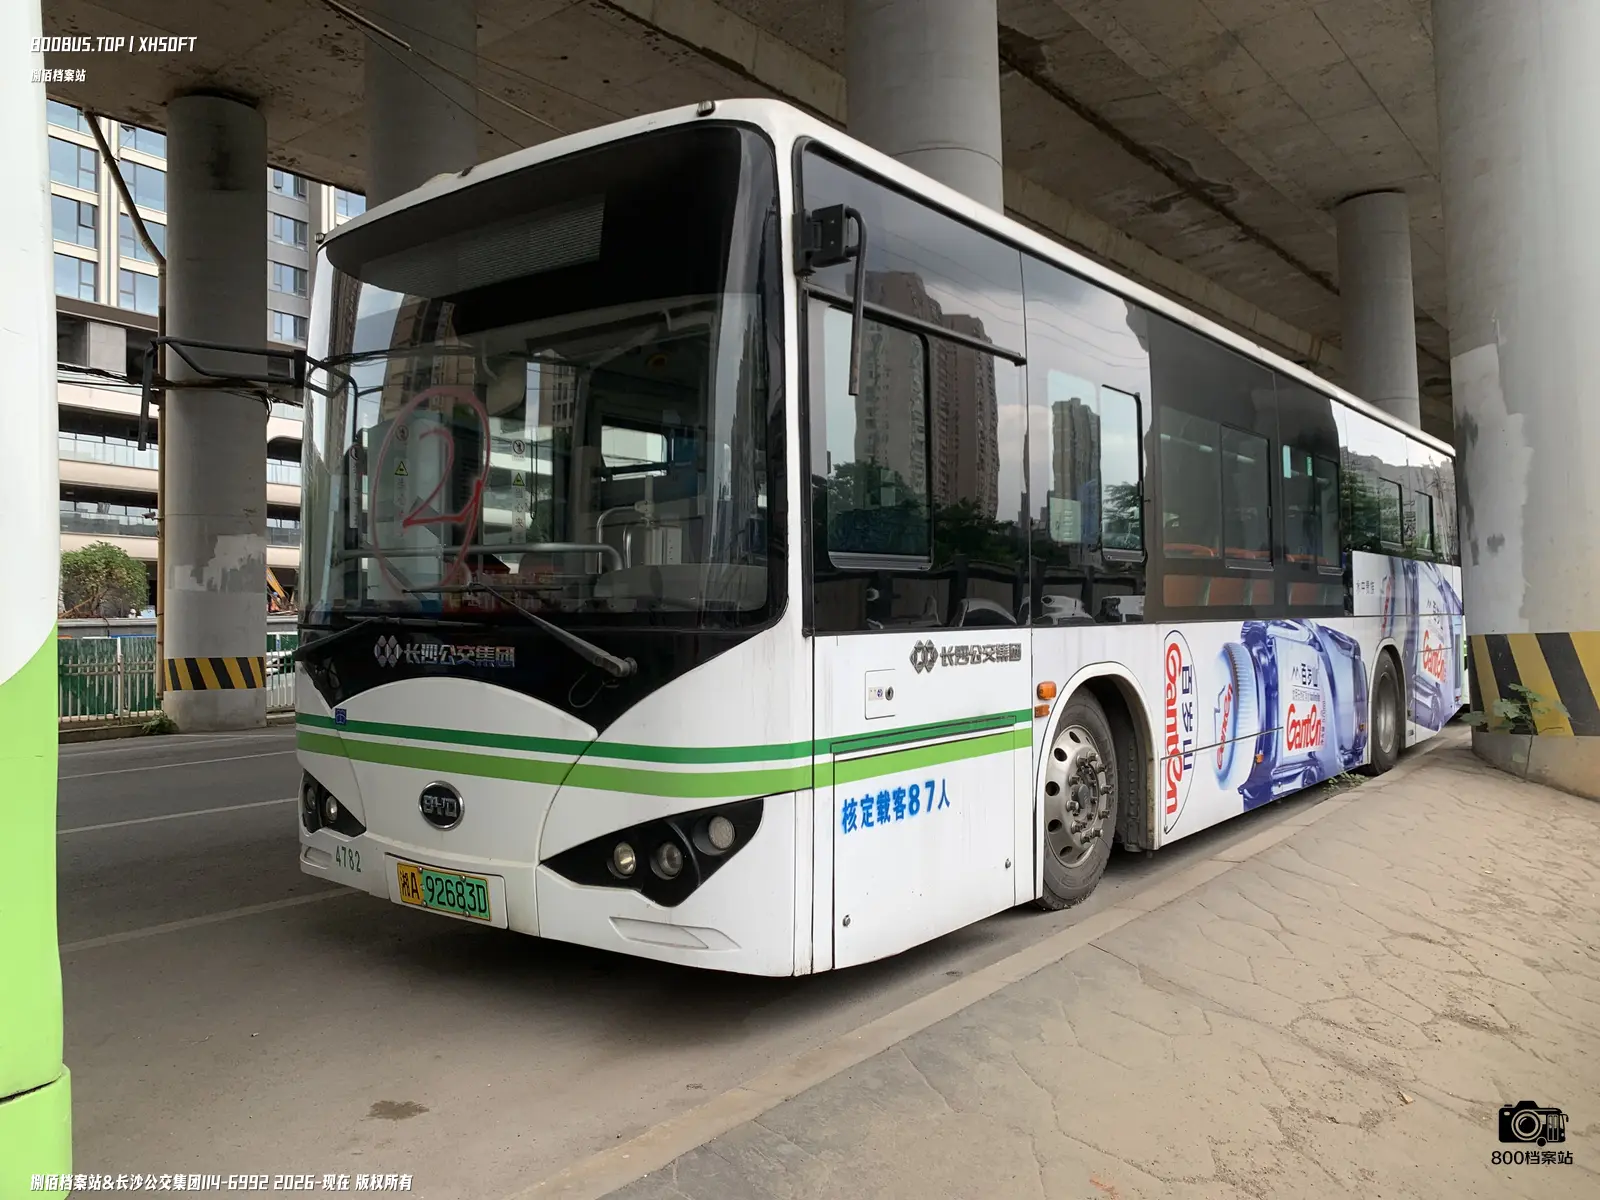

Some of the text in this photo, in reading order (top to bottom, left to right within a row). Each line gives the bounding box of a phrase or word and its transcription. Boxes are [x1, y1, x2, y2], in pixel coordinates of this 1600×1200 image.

[404, 642, 516, 669] 长沙公交集团
[940, 643, 1022, 667] 长沙公交集团
[423, 794, 458, 818] BYD
[841, 779, 951, 834] 核定载客87人
[335, 844, 362, 873] 4782
